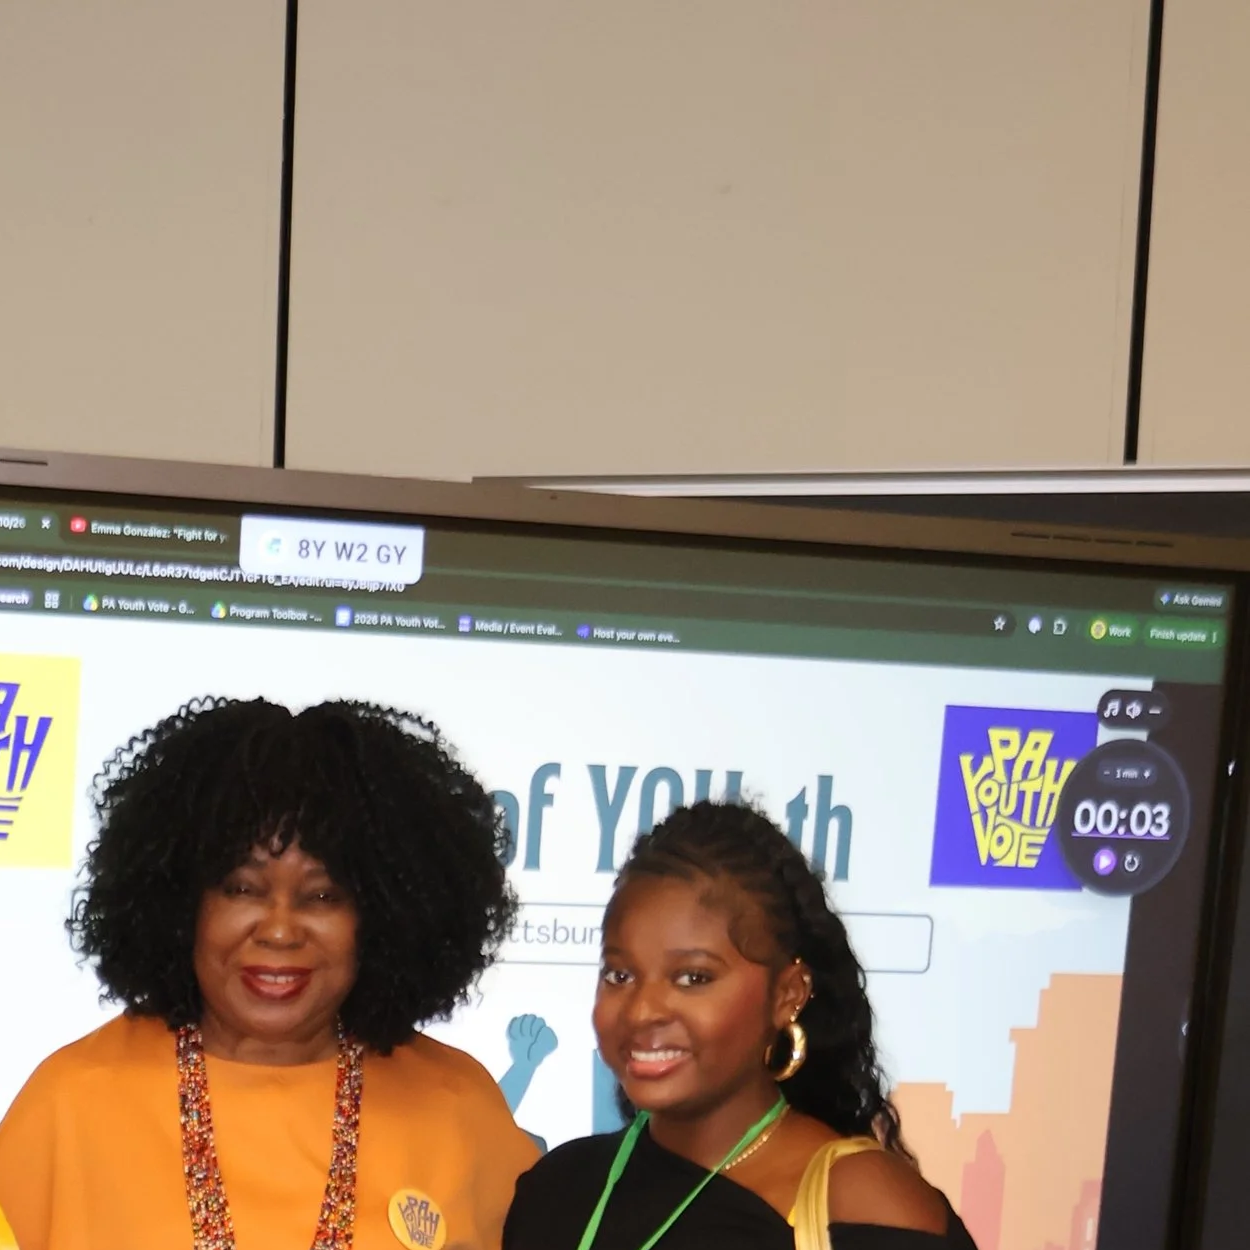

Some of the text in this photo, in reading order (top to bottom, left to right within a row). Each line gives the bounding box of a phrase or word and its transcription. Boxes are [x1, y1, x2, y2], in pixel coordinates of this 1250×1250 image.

[90, 521, 121, 536] Emma
[203, 528, 218, 542] for
[297, 538, 408, 566] 8Y W2 GY
[102, 596, 116, 609] PA
[117, 598, 146, 612] Youth
[147, 600, 170, 613] Vote
[1172, 594, 1190, 606] Ask
[230, 603, 270, 620] Program
[271, 607, 308, 622] Toolbox
[379, 614, 393, 627] PA
[394, 615, 422, 629] Youth
[474, 619, 503, 634] Media
[509, 622, 535, 635] Event
[593, 626, 615, 639] Host
[616, 629, 637, 642] your
[637, 631, 656, 643] own
[1109, 625, 1132, 638] Work
[1150, 628, 1207, 643] Finish update
[987, 726, 1055, 785] PA
[959, 753, 1078, 830] YOUTH
[1073, 799, 1171, 838] 00:03
[971, 807, 1051, 869] VOTE
